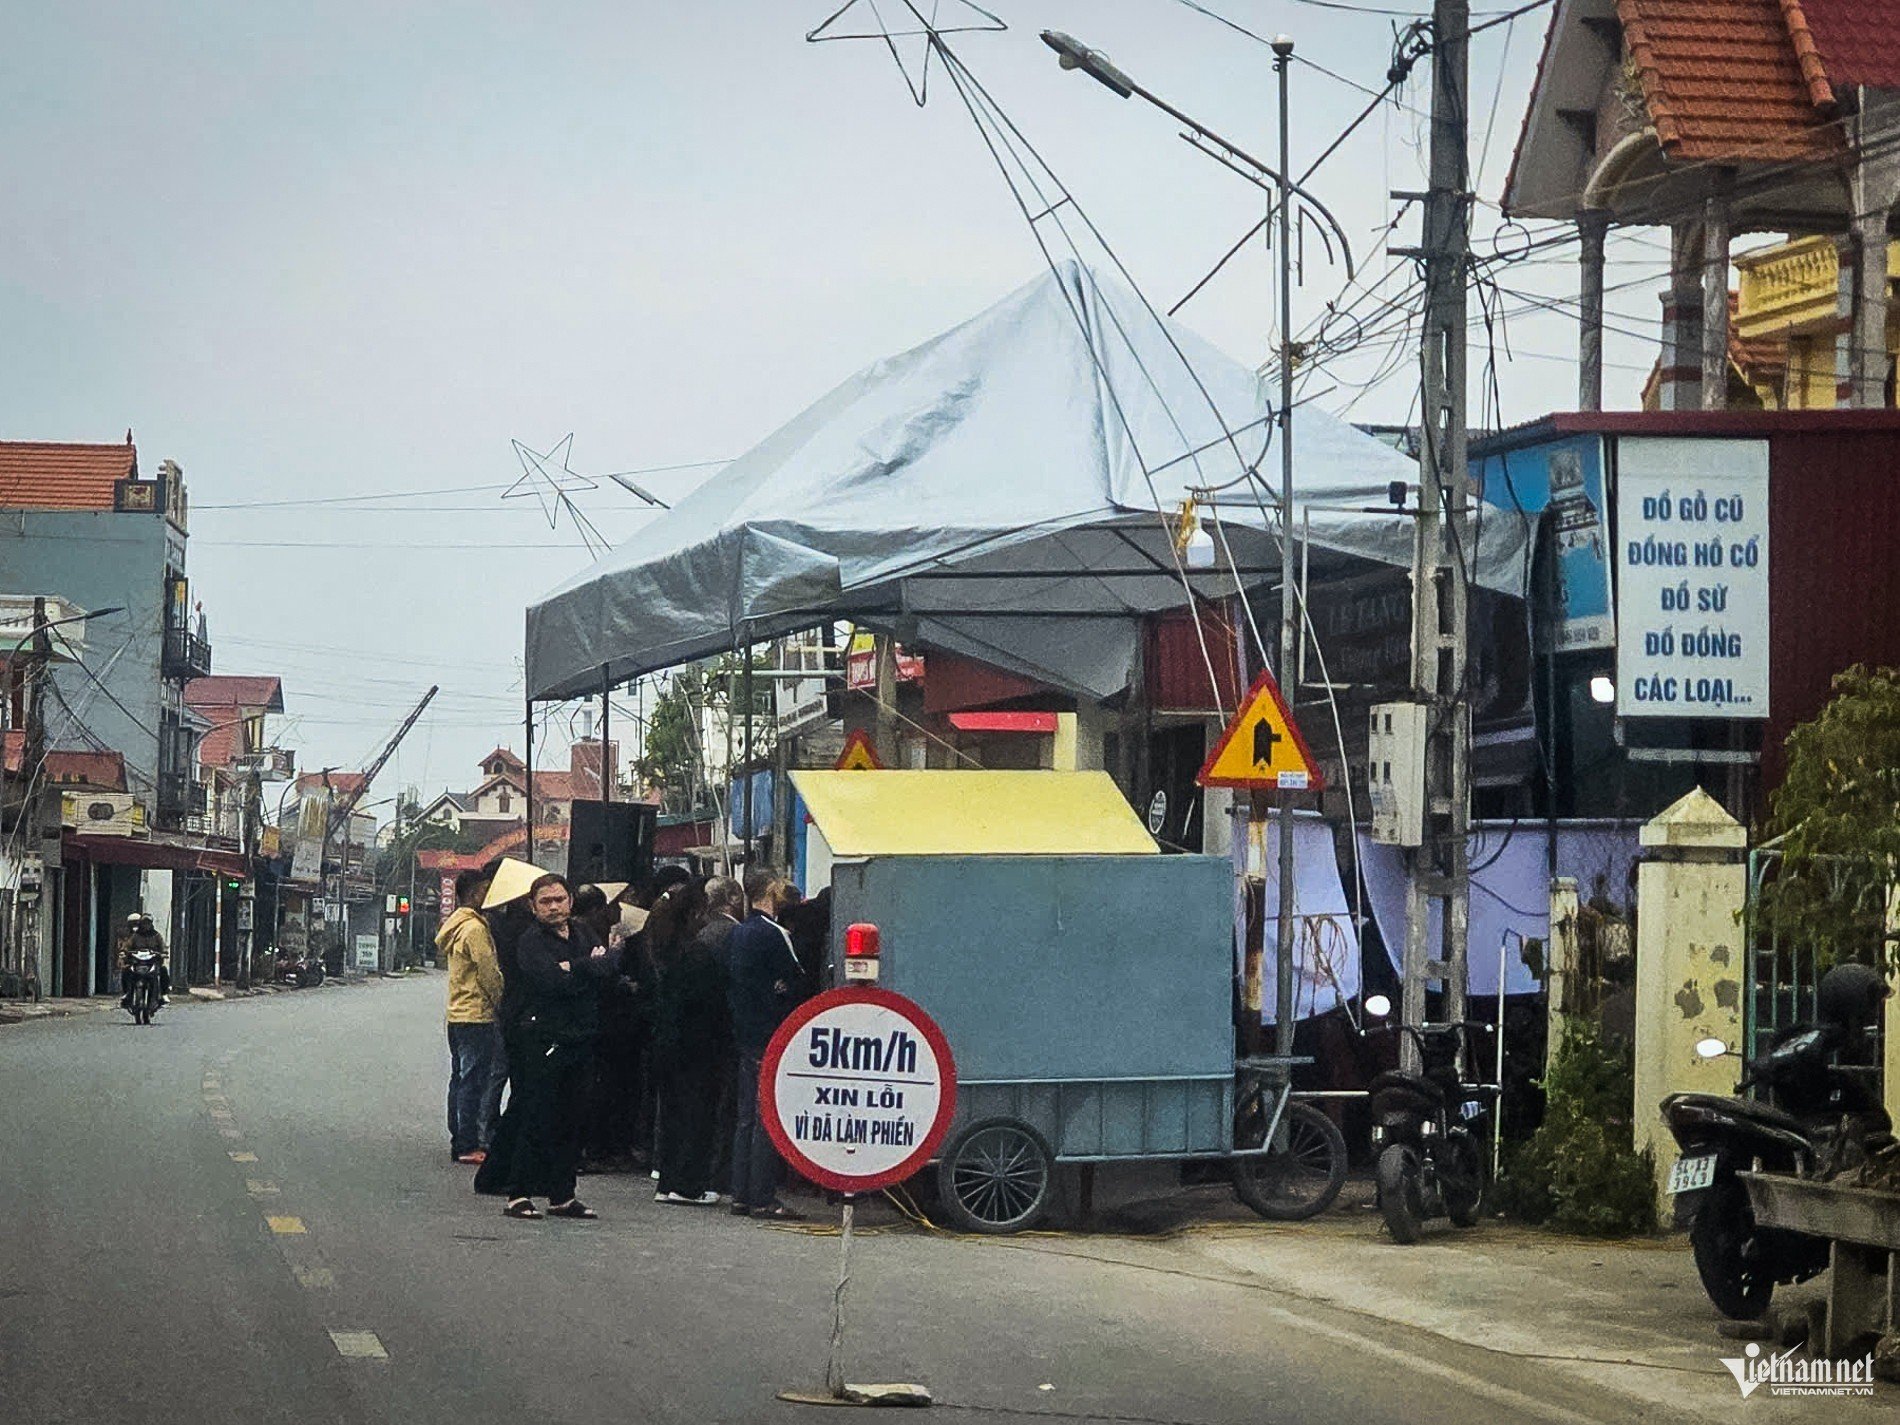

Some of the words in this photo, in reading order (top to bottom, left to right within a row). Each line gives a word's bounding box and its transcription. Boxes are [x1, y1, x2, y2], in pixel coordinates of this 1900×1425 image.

[1714, 494, 1744, 522] CŨ
[1634, 672, 1677, 702] CÁC
[809, 1027, 917, 1073] 5km/h
[814, 1087, 859, 1106] XIN
[866, 1083, 904, 1109] LỖI
[795, 1110, 809, 1140] VÌ
[812, 1113, 833, 1142] ĐÃ
[836, 1114, 868, 1144] LÀM
